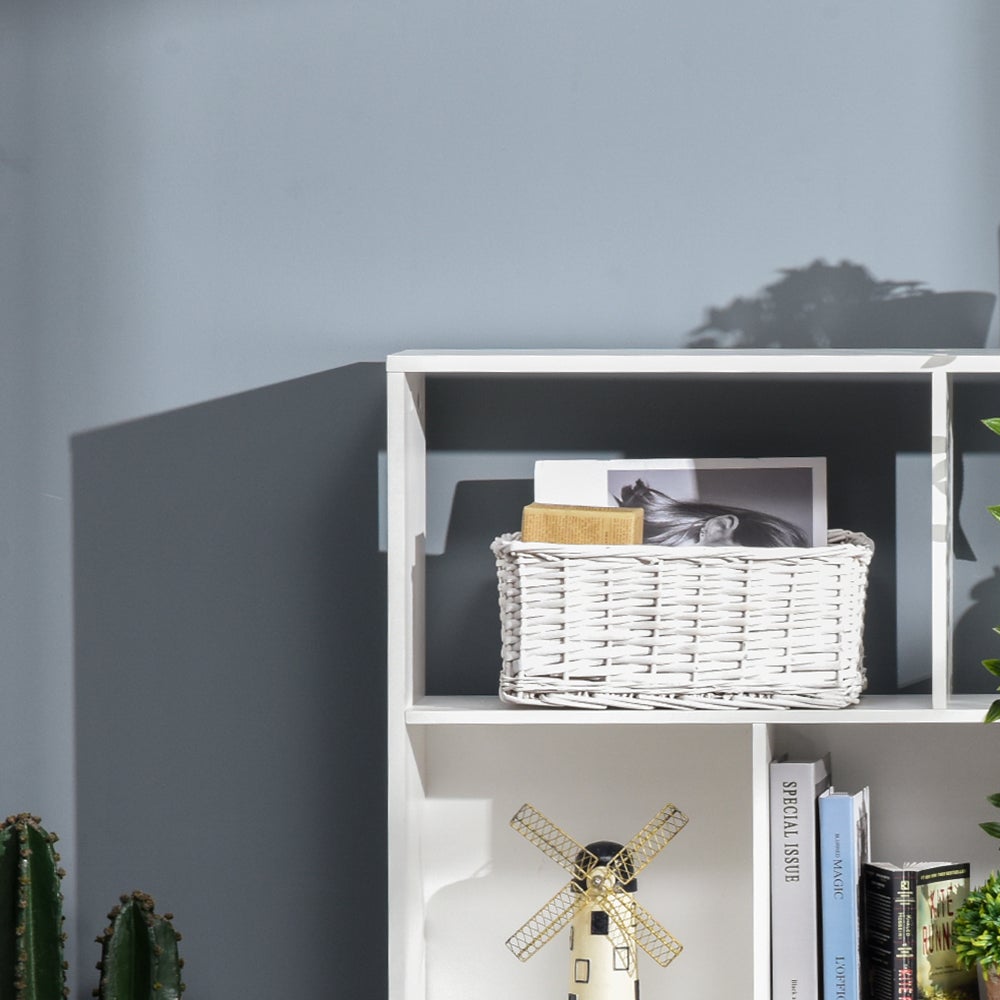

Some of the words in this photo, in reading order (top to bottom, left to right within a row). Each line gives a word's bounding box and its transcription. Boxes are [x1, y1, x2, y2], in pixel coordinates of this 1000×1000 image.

[783, 781, 798, 838] SPECIAL
[784, 843, 800, 882] ISSUE
[833, 859, 844, 900] MAGIC
[922, 922, 954, 955] RUNN
